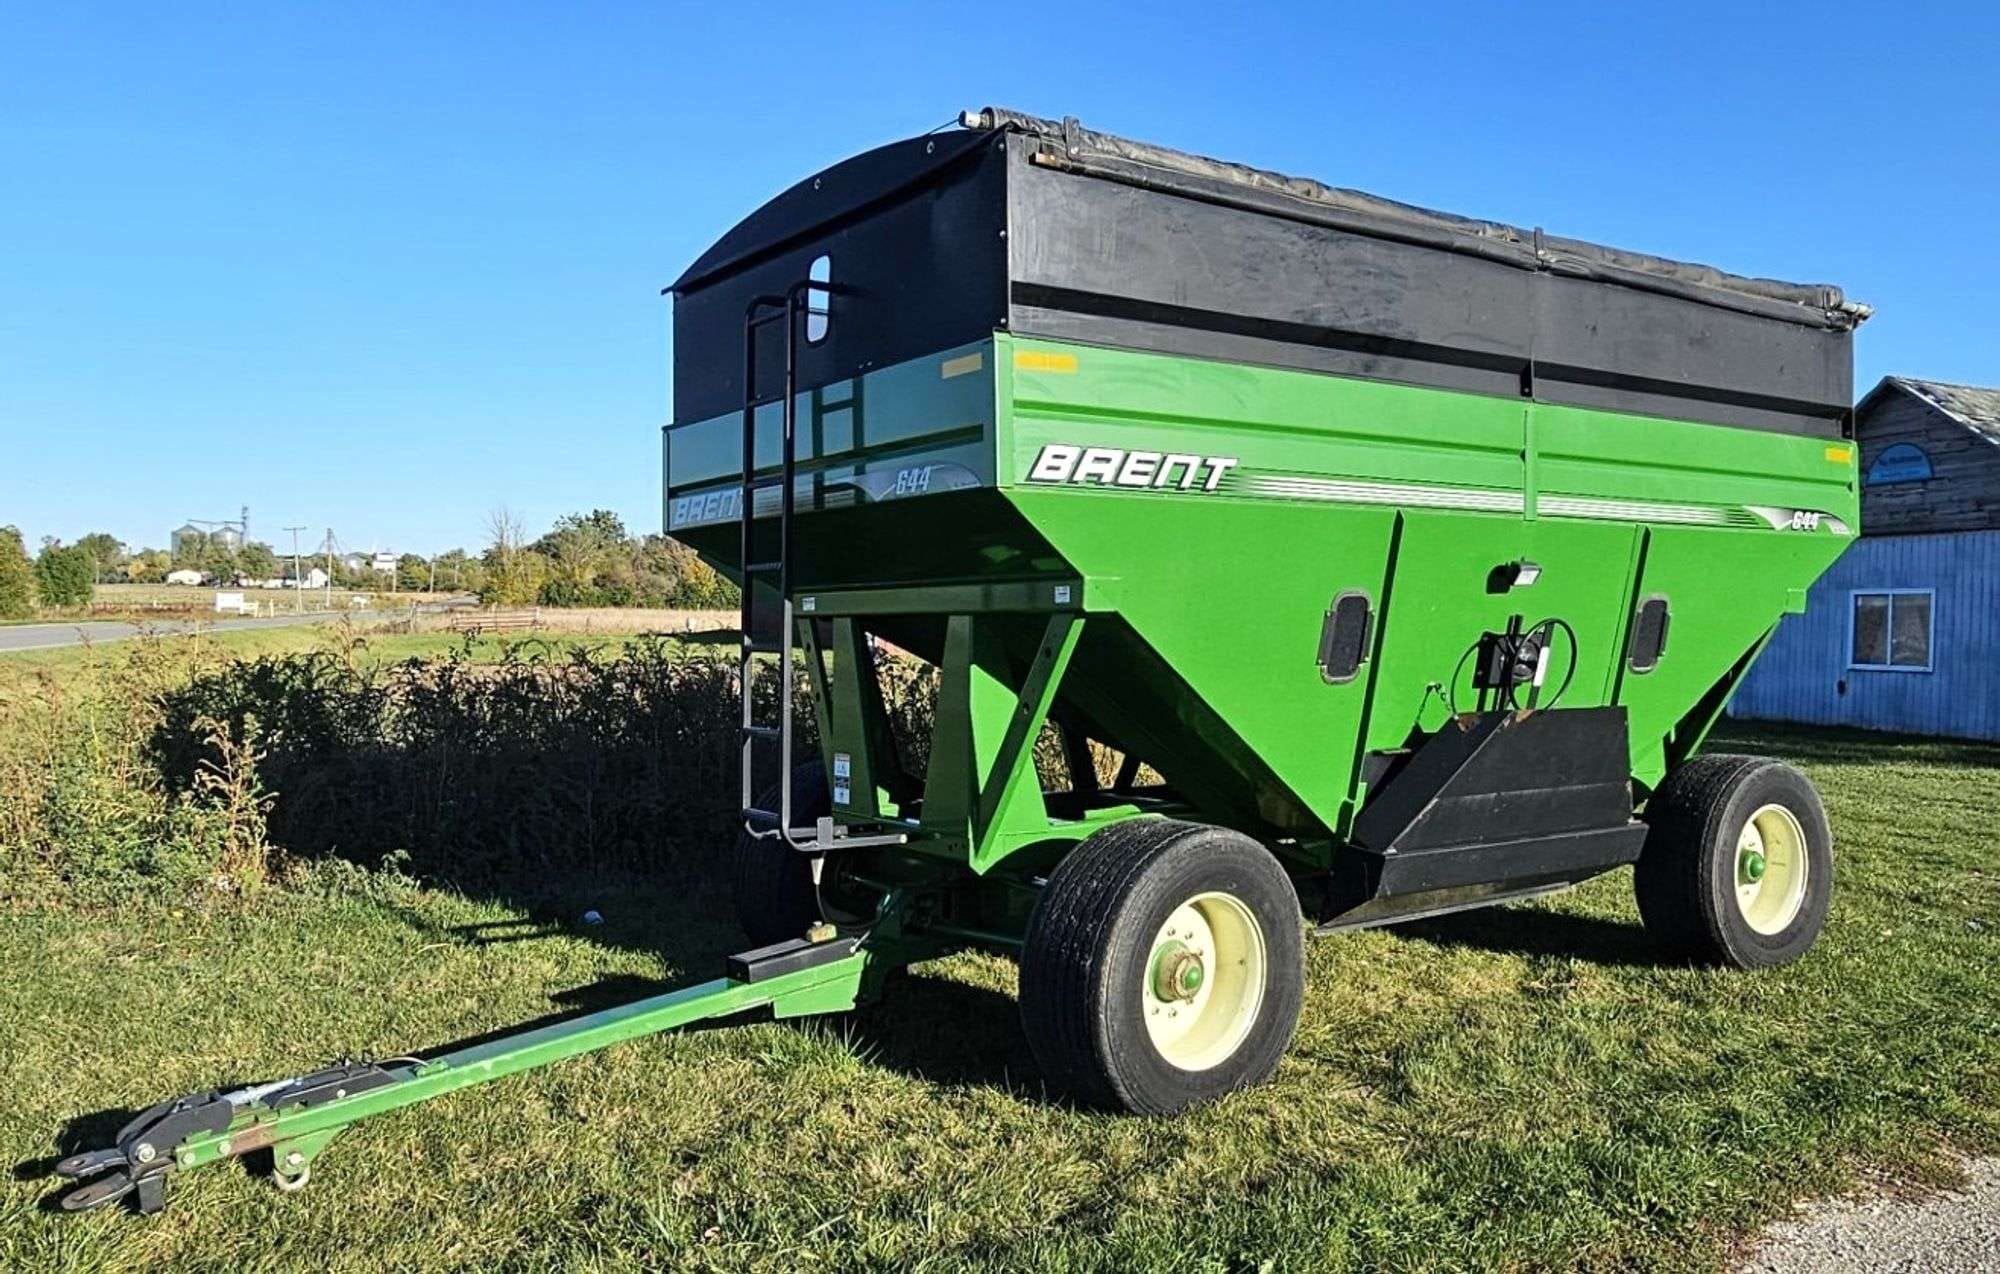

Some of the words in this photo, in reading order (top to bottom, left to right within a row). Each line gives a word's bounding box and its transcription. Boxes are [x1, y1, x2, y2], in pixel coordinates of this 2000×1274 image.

[896, 465, 931, 495] 644
[1026, 444, 1239, 491] BRENT
[673, 486, 743, 526] BREN
